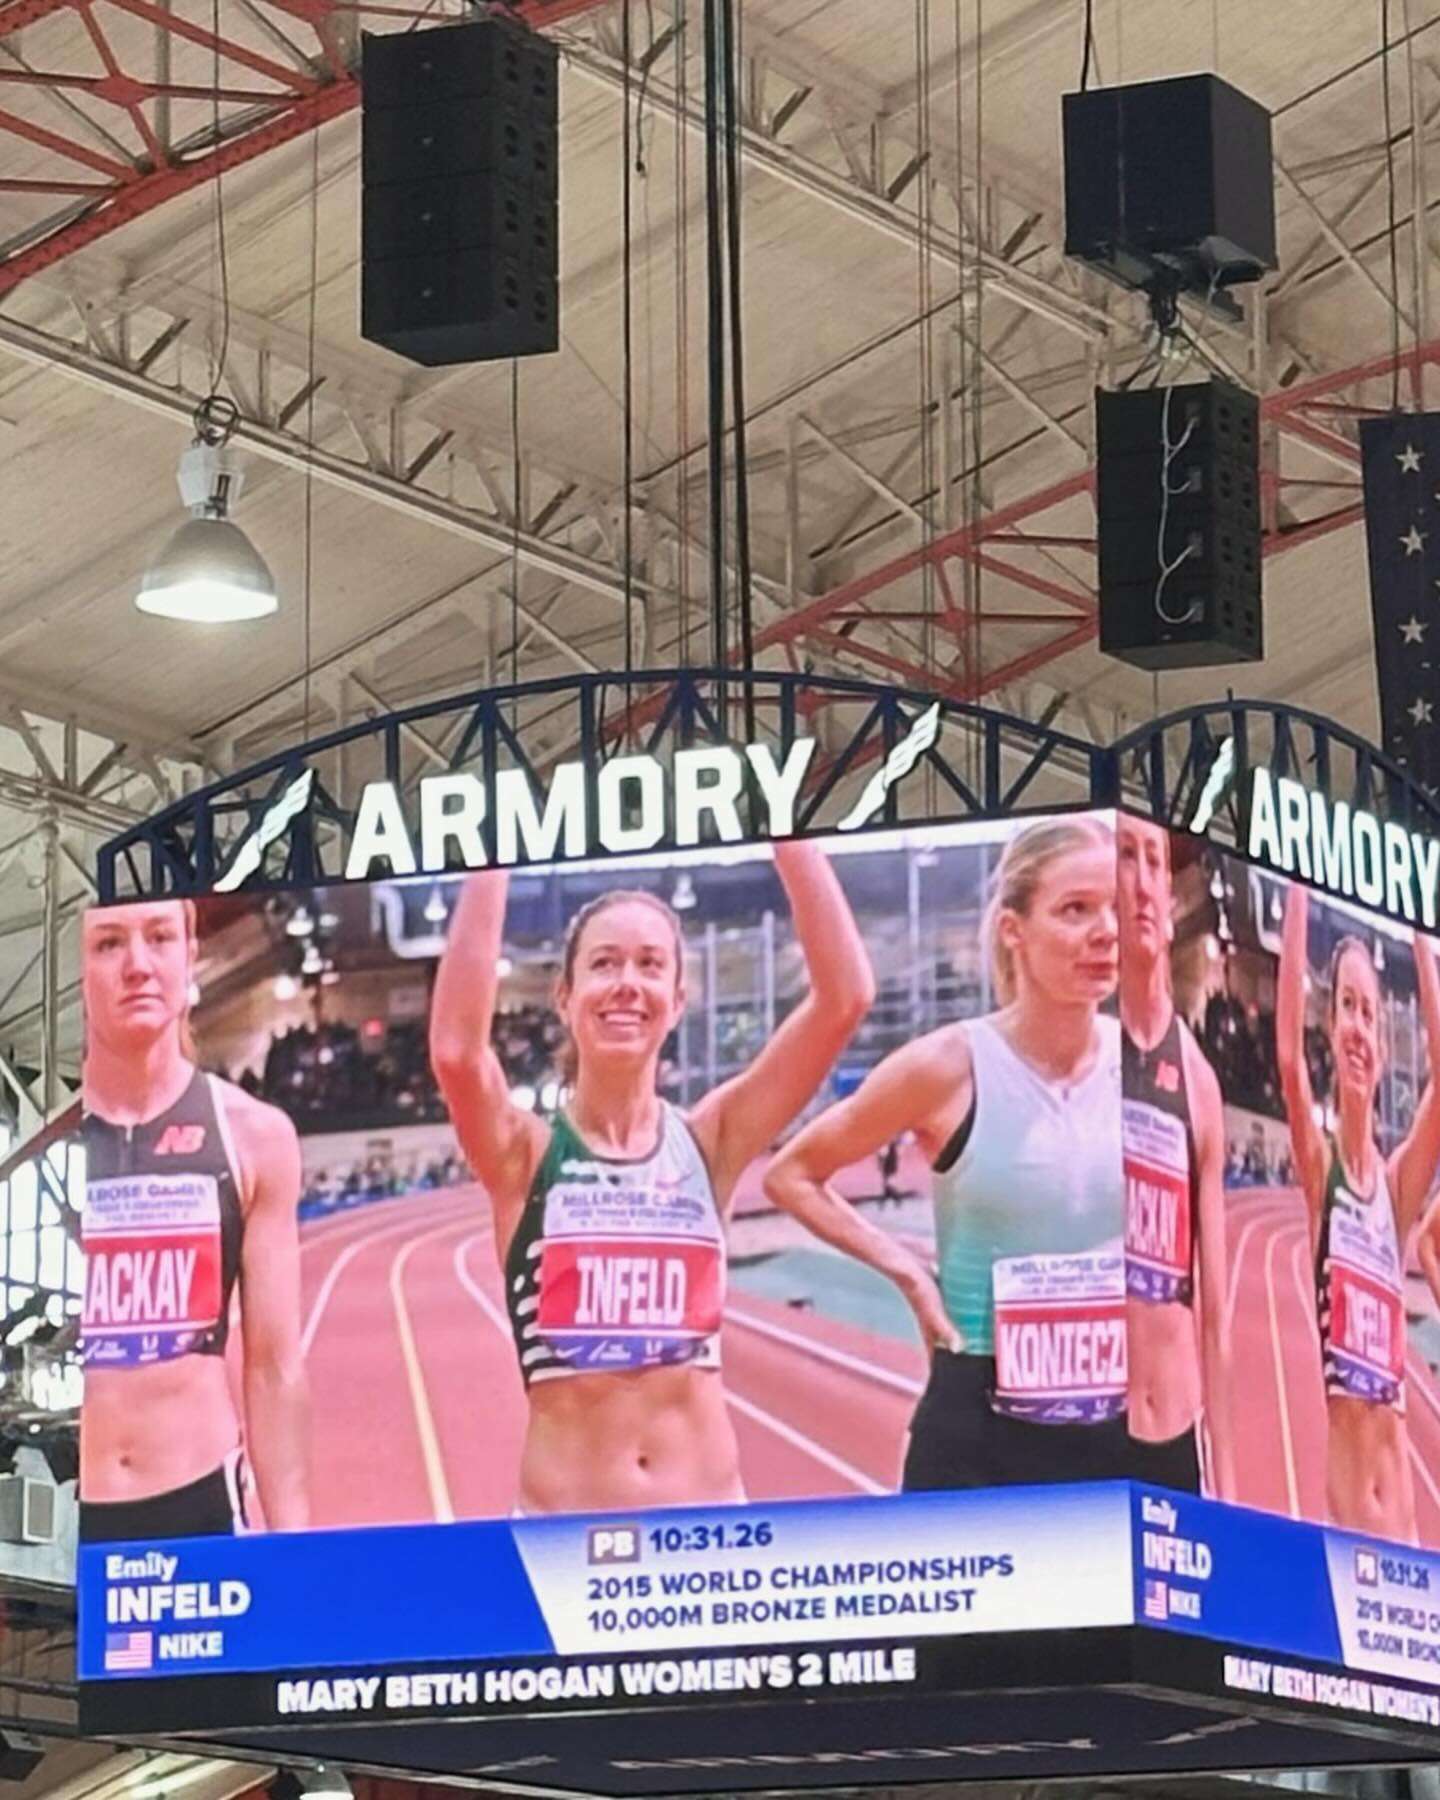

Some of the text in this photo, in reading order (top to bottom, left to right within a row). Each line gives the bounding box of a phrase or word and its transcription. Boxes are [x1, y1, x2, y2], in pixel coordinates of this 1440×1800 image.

[345, 737, 815, 880] ARMORY
[1249, 765, 1440, 928] ARMORY
[574, 1255, 687, 1326] INFELD
[592, 1522, 773, 1559] PB 10:31.26
[1143, 1531, 1212, 1580] INFELD
[105, 1551, 178, 1582] Emily
[587, 1553, 1015, 1600] 2015 WORLD CHAMPIONSHIPS
[106, 1580, 252, 1624] INFELD
[587, 1588, 977, 1634] 10,000M BRONZE MEDALIST
[159, 1631, 224, 1660] NIKE
[277, 1648, 916, 1714] MARY BETH HOGAN WOMEN'S 2 MILE
